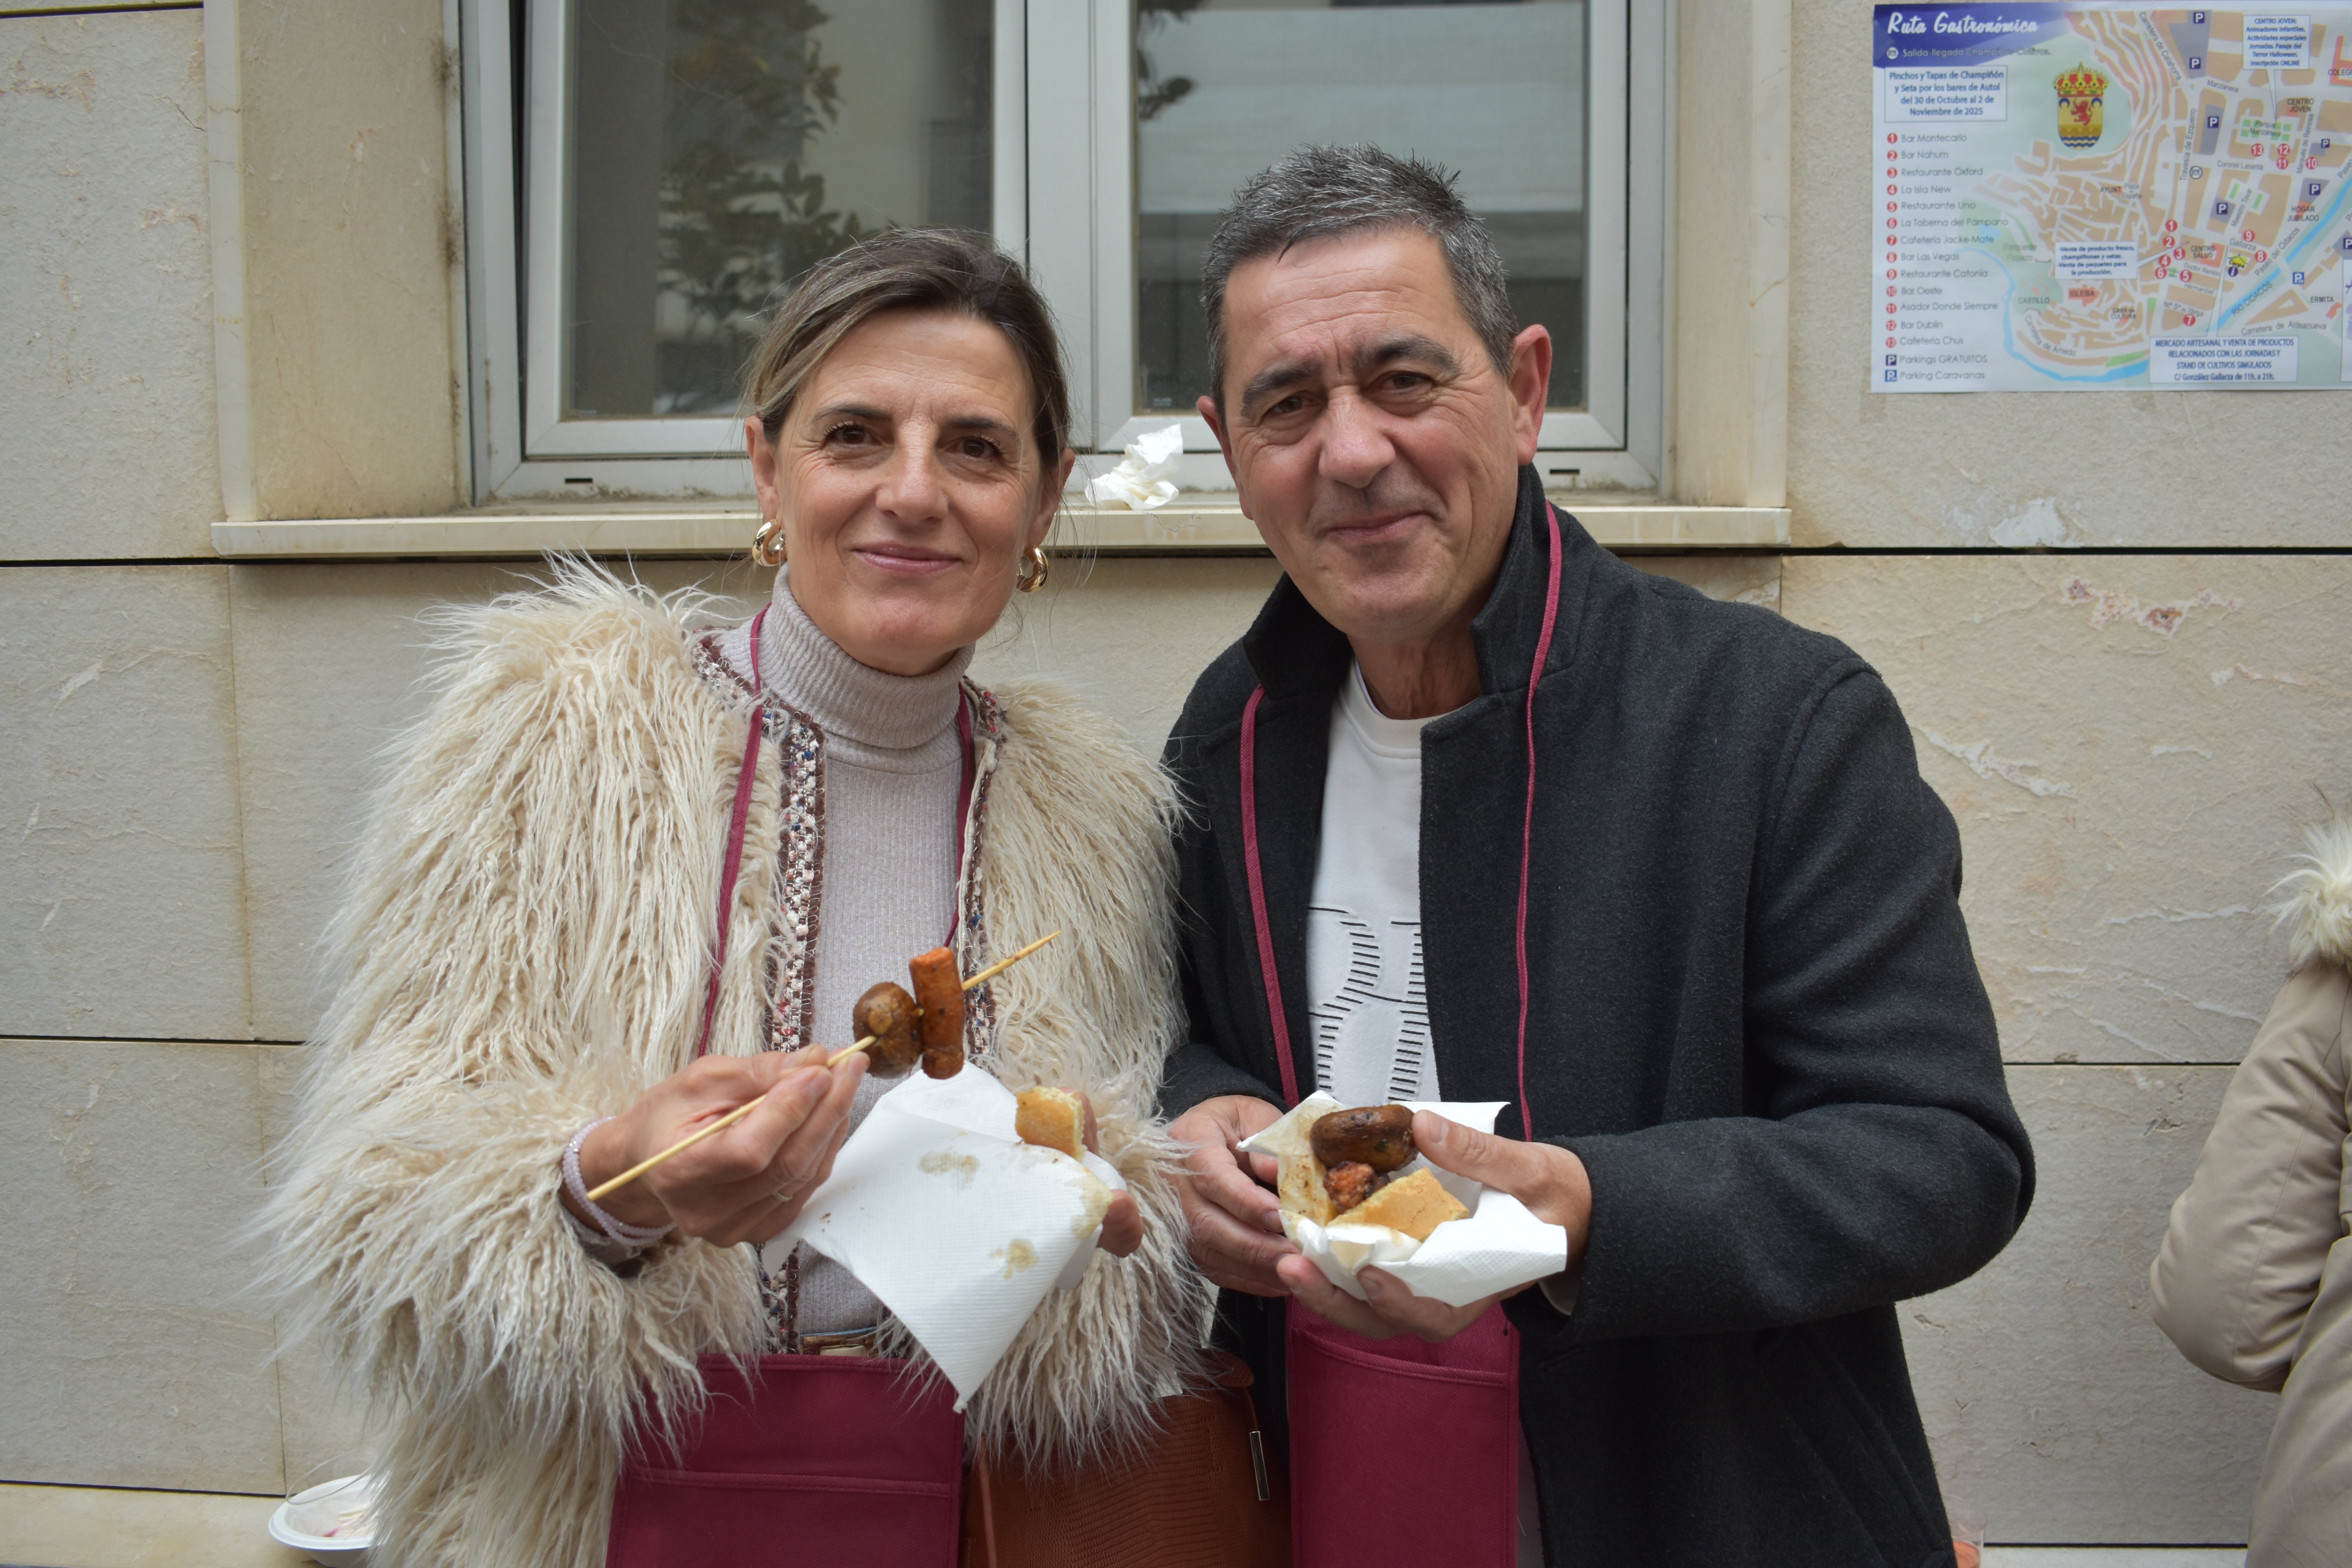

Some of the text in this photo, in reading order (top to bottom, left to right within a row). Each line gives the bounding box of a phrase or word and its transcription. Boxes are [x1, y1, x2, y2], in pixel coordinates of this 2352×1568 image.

[1887, 12, 2038, 34] Ruta Gastronómica
[2139, 12, 2181, 81] Carretera de Calahorra
[1903, 48, 1964, 58] Salida-llegada
[1926, 72, 1947, 80] Tapas
[1960, 71, 2004, 80] Champiñón
[1920, 86, 1931, 94] por
[2207, 80, 2238, 93] Manzanera
[2185, 109, 2196, 140] Ezquerro
[2184, 142, 2191, 151] de
[2253, 146, 2262, 154] 13
[2279, 145, 2288, 154] 12
[2217, 160, 2239, 169] Coronel
[2278, 159, 2287, 167] 11
[2307, 159, 2317, 167] 10
[1966, 218, 2008, 227] Pámpano
[1943, 236, 1993, 244] Jacke-Mate
[2230, 238, 2256, 251] Gallarza
[2255, 227, 2300, 276] Paseo del Cidacos
[1933, 252, 1959, 262] Vegas
[2244, 281, 2272, 306] CIDACOS
[1964, 302, 1997, 312] Siempre
[2241, 325, 2272, 336] Carretera
[2288, 321, 2326, 330] Aldeanueva
[1943, 336, 1963, 345] Chus
[1900, 356, 1936, 364] Parkings
[1900, 371, 1985, 381] Parking Caravanas
